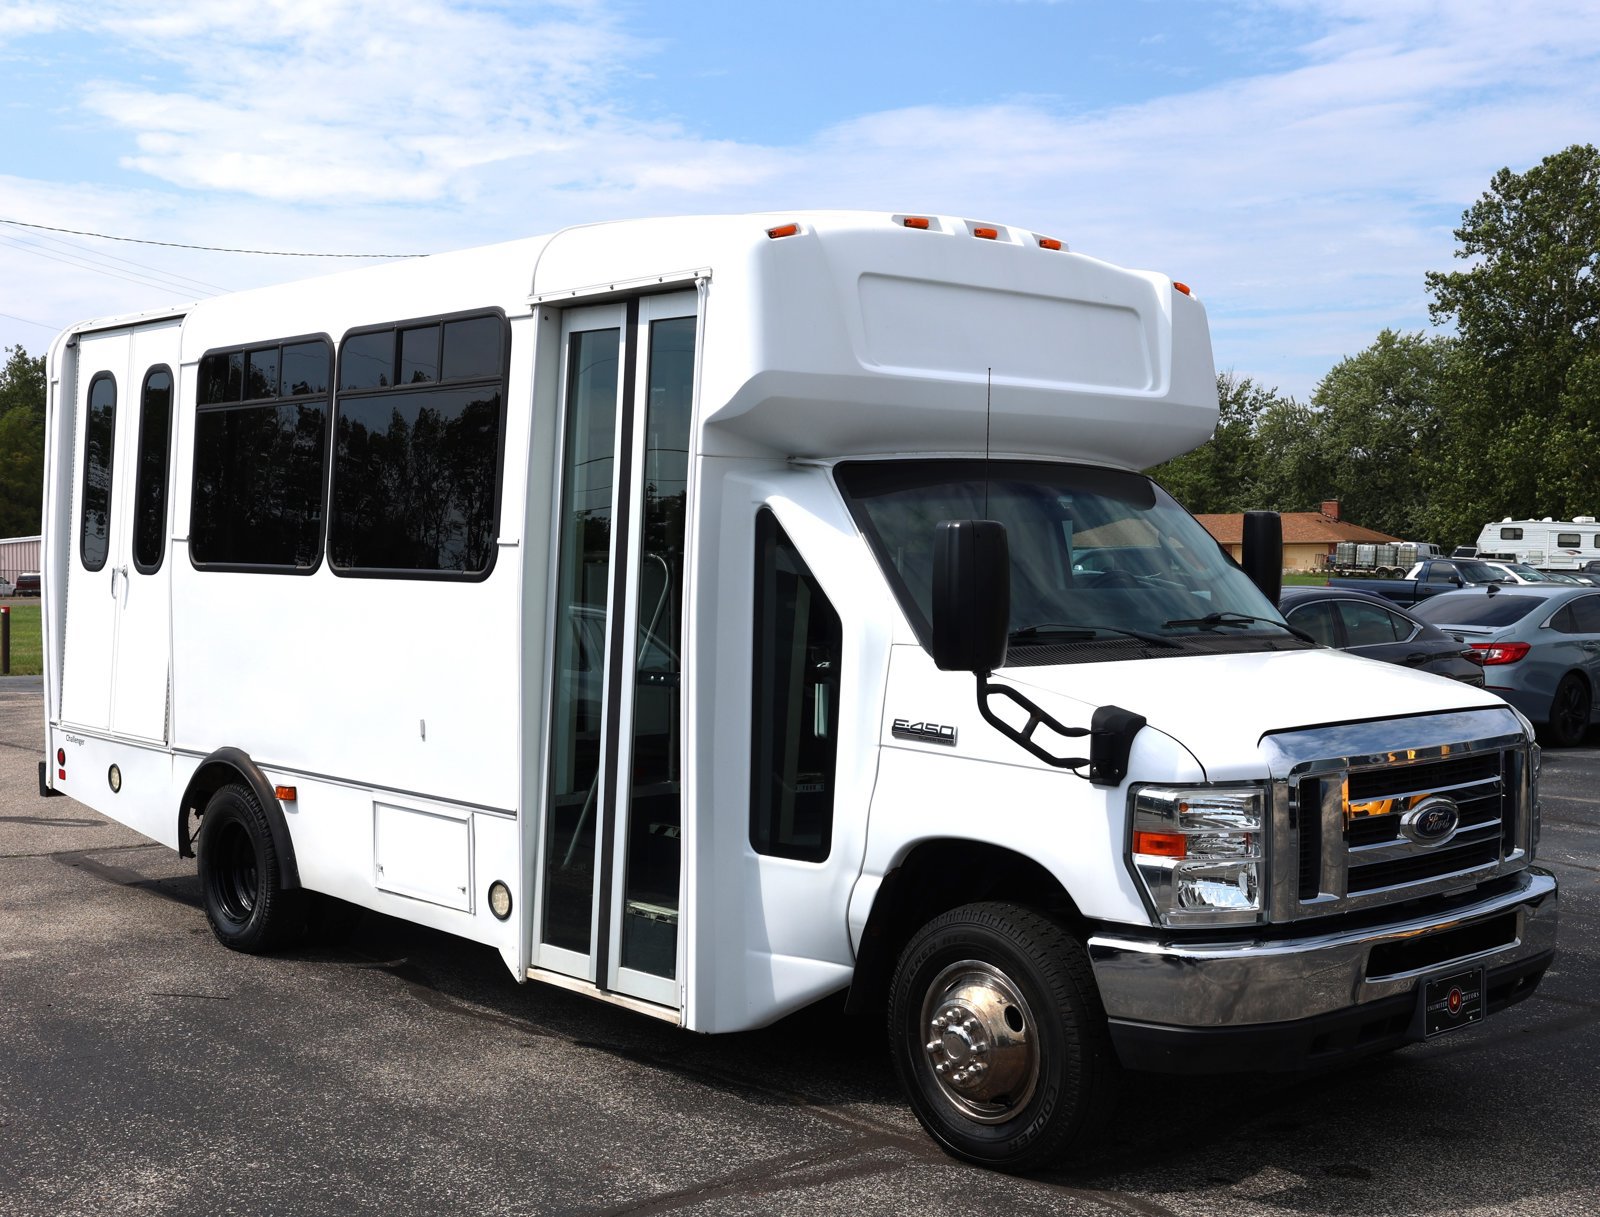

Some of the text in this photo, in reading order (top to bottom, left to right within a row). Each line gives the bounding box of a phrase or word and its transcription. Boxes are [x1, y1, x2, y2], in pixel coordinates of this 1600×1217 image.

[893, 718, 954, 739] E-450
[1427, 811, 1450, 830] Ford
[1008, 1084, 1058, 1152] COOPER
